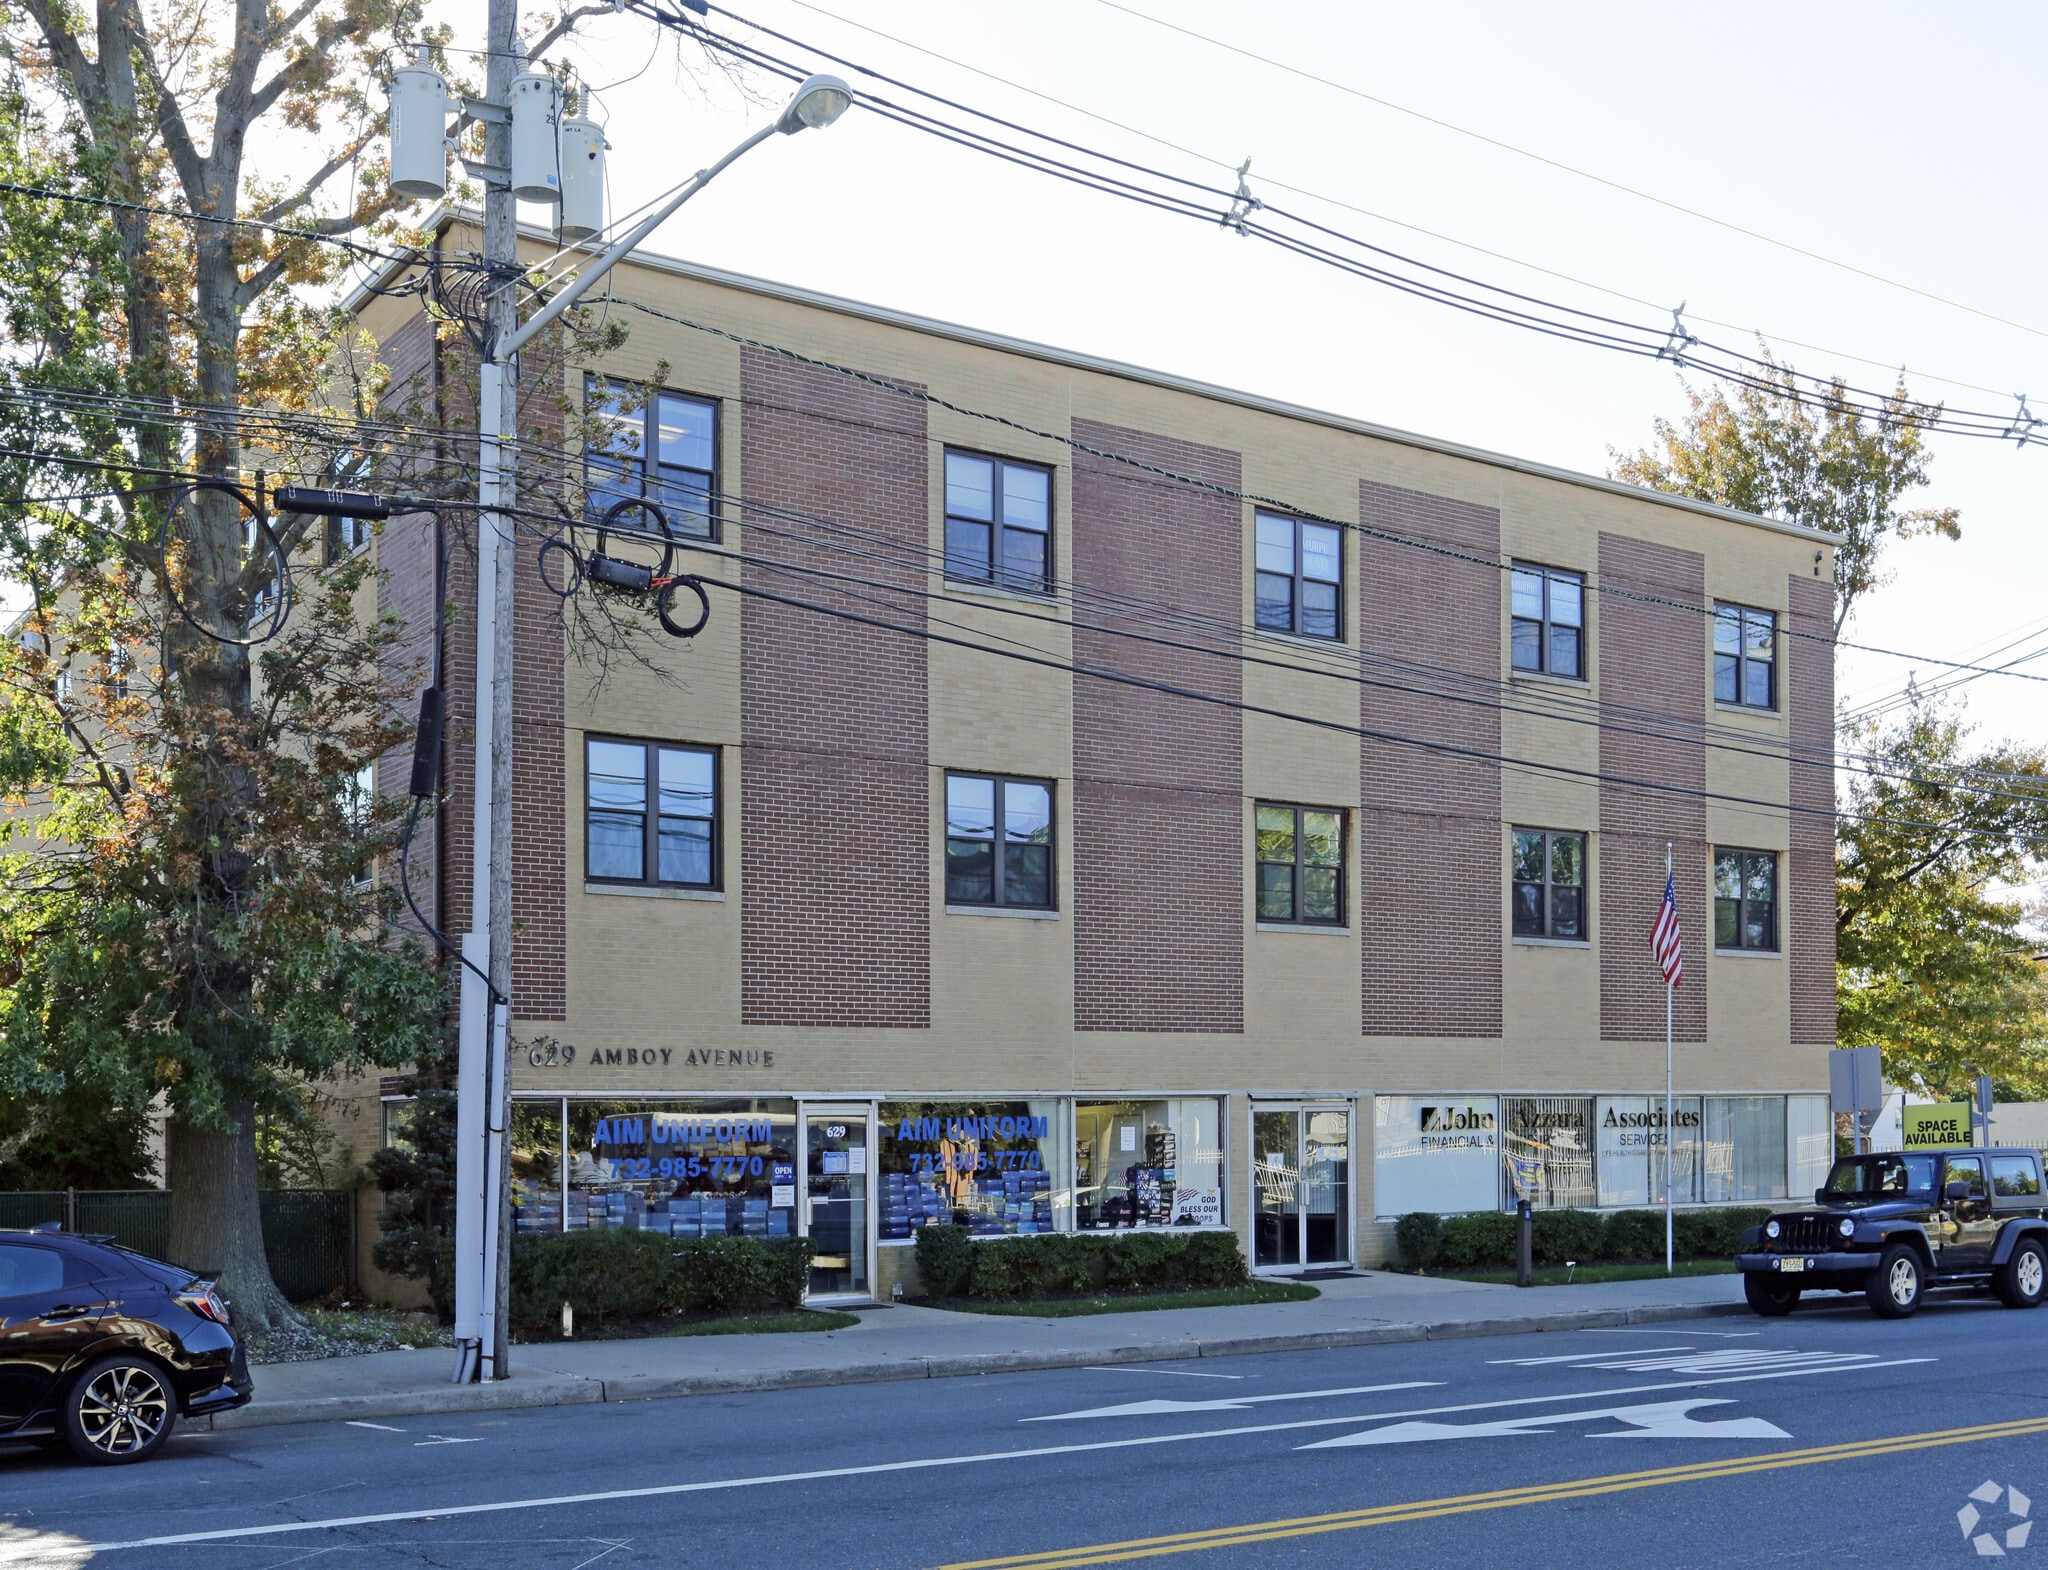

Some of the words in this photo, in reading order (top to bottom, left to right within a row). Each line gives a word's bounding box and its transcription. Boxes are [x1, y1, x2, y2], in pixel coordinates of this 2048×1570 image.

[529, 1042, 577, 1067] 629
[589, 1048, 673, 1065] AMBOY
[685, 1048, 775, 1066] AVENUE
[898, 1117, 941, 1141] AIM
[946, 1116, 1048, 1140] UNIFORM
[1443, 1106, 1495, 1131] John
[1512, 1106, 1584, 1129] Azzara
[1603, 1106, 1700, 1128] Associates
[1917, 1119, 1958, 1132] SPACE
[594, 1119, 644, 1144] AIM
[651, 1118, 772, 1144] UNIFORM
[826, 1126, 846, 1138] 629
[1421, 1136, 1484, 1148] FINANCIAL
[1487, 1135, 1495, 1145] &
[1620, 1133, 1668, 1146] SERVICES
[1905, 1131, 1970, 1145] AVAILABLE
[608, 1156, 763, 1179] 732-985-7770
[775, 1166, 792, 1175] OPEN
[909, 1151, 1041, 1172] 732-985-7770
